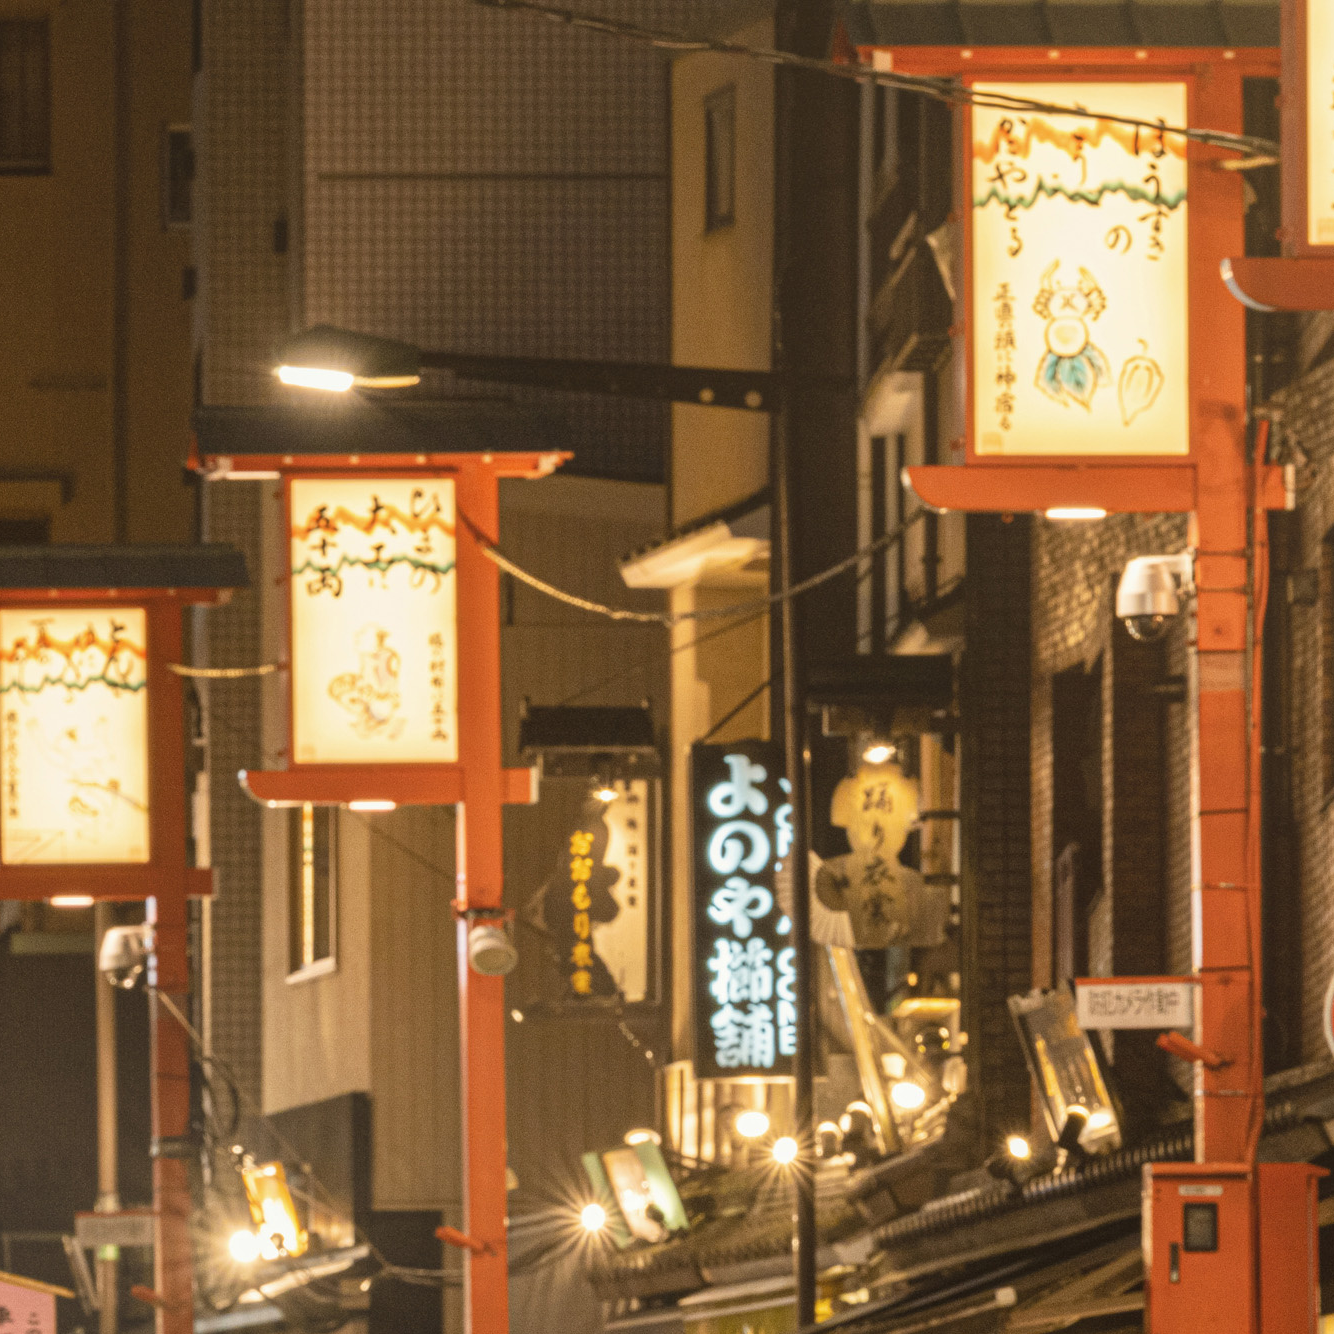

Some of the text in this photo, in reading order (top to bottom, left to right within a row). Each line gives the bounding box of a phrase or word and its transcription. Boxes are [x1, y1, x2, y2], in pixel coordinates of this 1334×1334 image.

[708, 754, 775, 1068] よのや櫛舗
